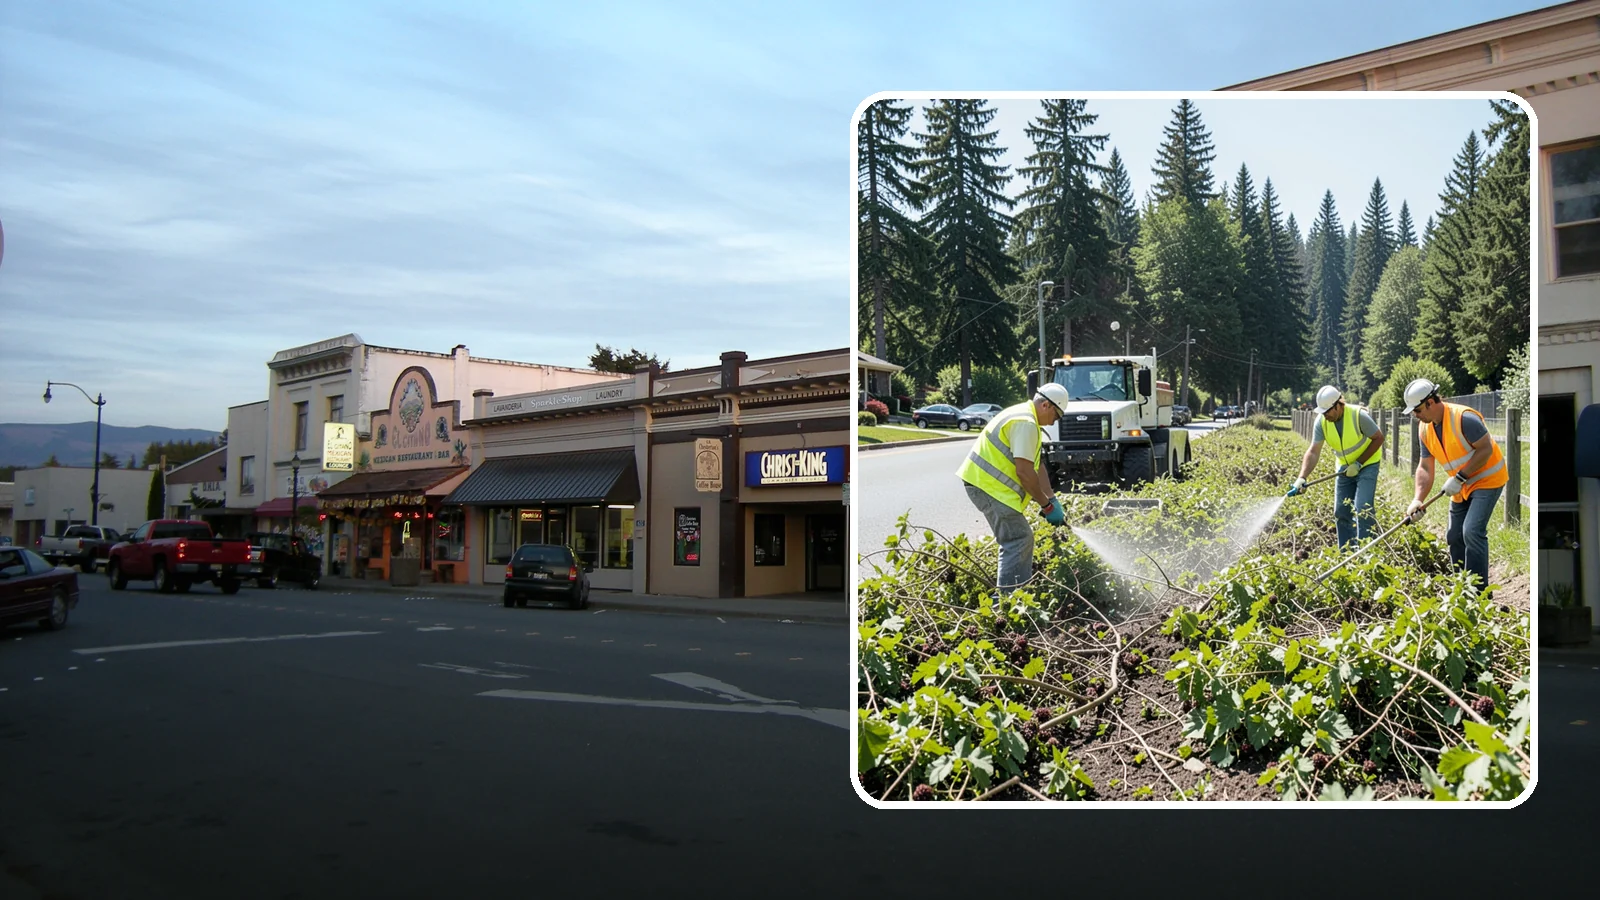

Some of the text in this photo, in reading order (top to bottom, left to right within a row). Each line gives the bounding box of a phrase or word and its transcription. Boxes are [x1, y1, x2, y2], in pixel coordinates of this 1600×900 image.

[493, 402, 523, 413] LAVANDERIA
[595, 389, 624, 400] LAUNDRY
[373, 450, 450, 464] MEXICAN RESTAURANT BAR
[800, 450, 827, 476] KING
